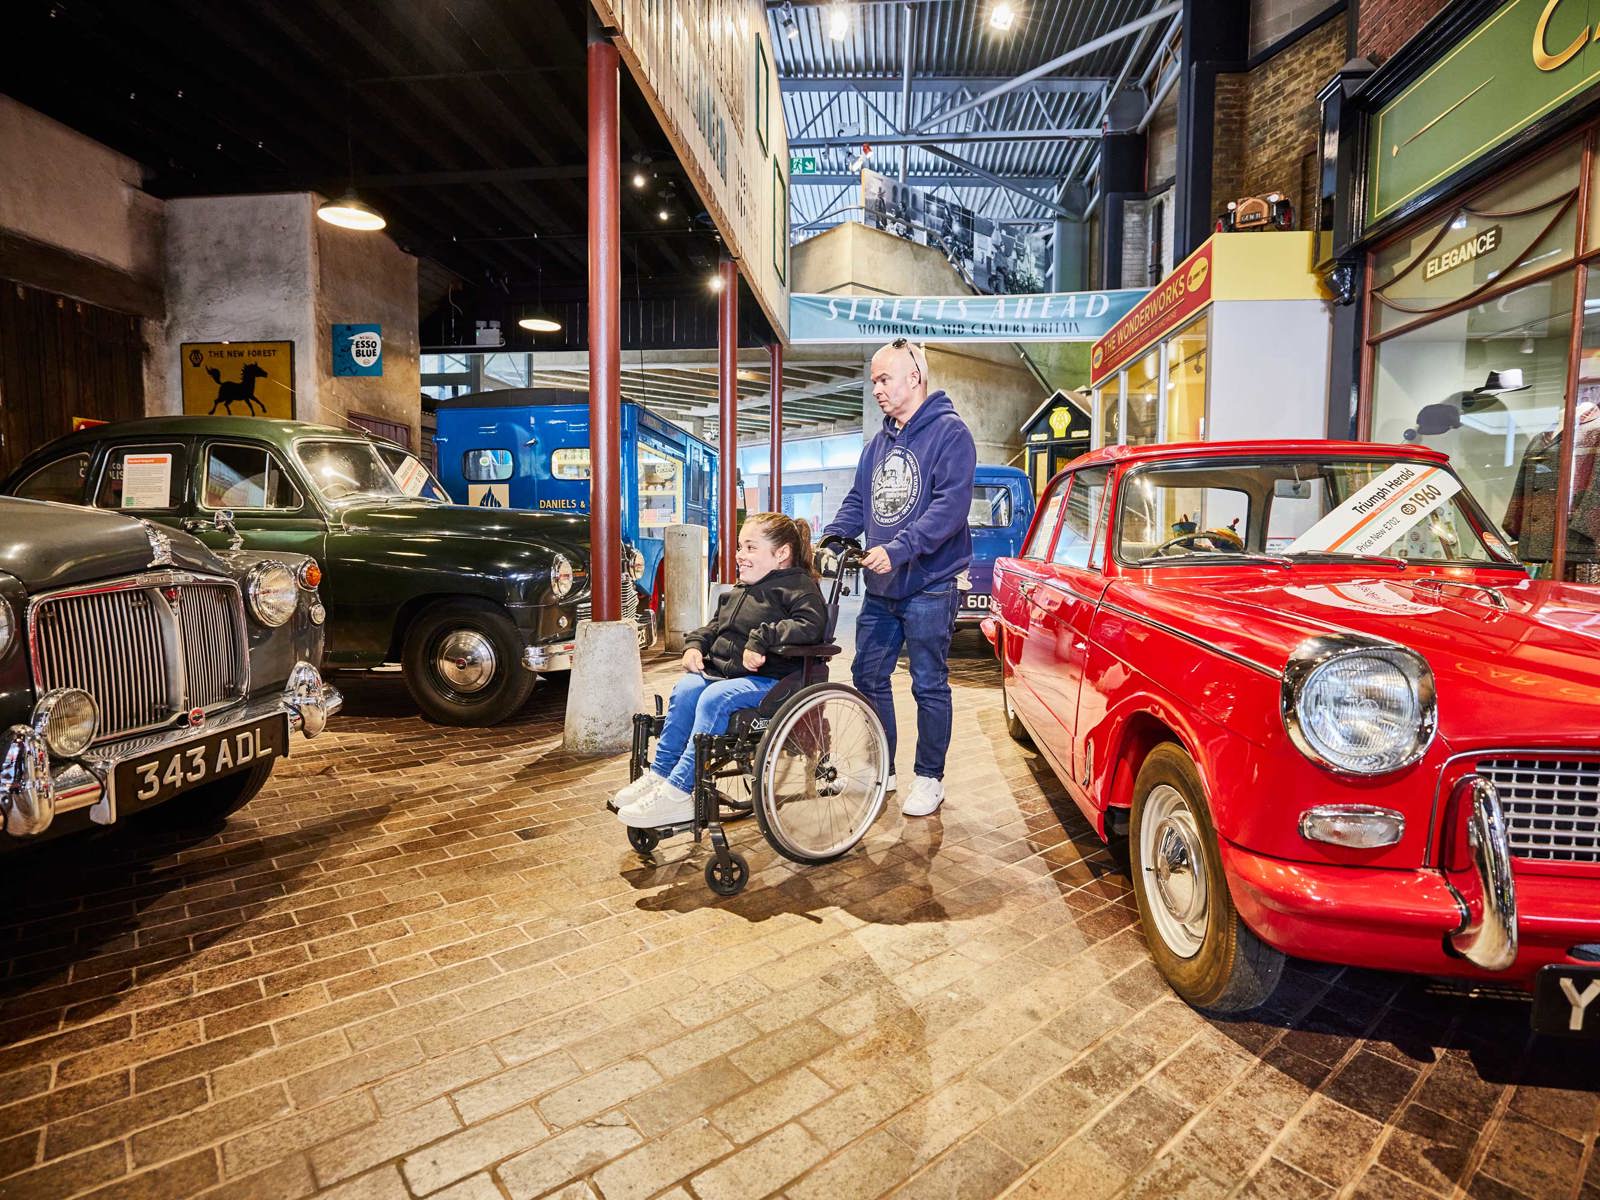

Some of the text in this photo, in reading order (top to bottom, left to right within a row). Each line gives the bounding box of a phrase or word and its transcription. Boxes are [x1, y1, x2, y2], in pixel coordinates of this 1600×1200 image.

[1426, 229, 1496, 279] ELEGANCE
[826, 294, 1109, 320] STREETS AHEAD
[1103, 334, 1116, 356] THE
[1117, 274, 1185, 344] WONDERWORKS
[858, 324, 919, 335] MOTORING
[925, 324, 936, 335] IN
[1032, 320, 1080, 334] BRITAIN
[208, 349, 276, 358] THE NEW FOREST
[355, 340, 377, 349] ESSO
[355, 348, 377, 358] BLUE
[539, 499, 586, 509] DANIELS &
[1352, 486, 1391, 515] Triumph
[1385, 468, 1415, 491] Herald
[1409, 484, 1442, 508] 1960
[1356, 538, 1373, 553] Price
[1371, 527, 1387, 543] New
[136, 727, 272, 801] 343 ADL
[1560, 977, 1600, 1030] Y
